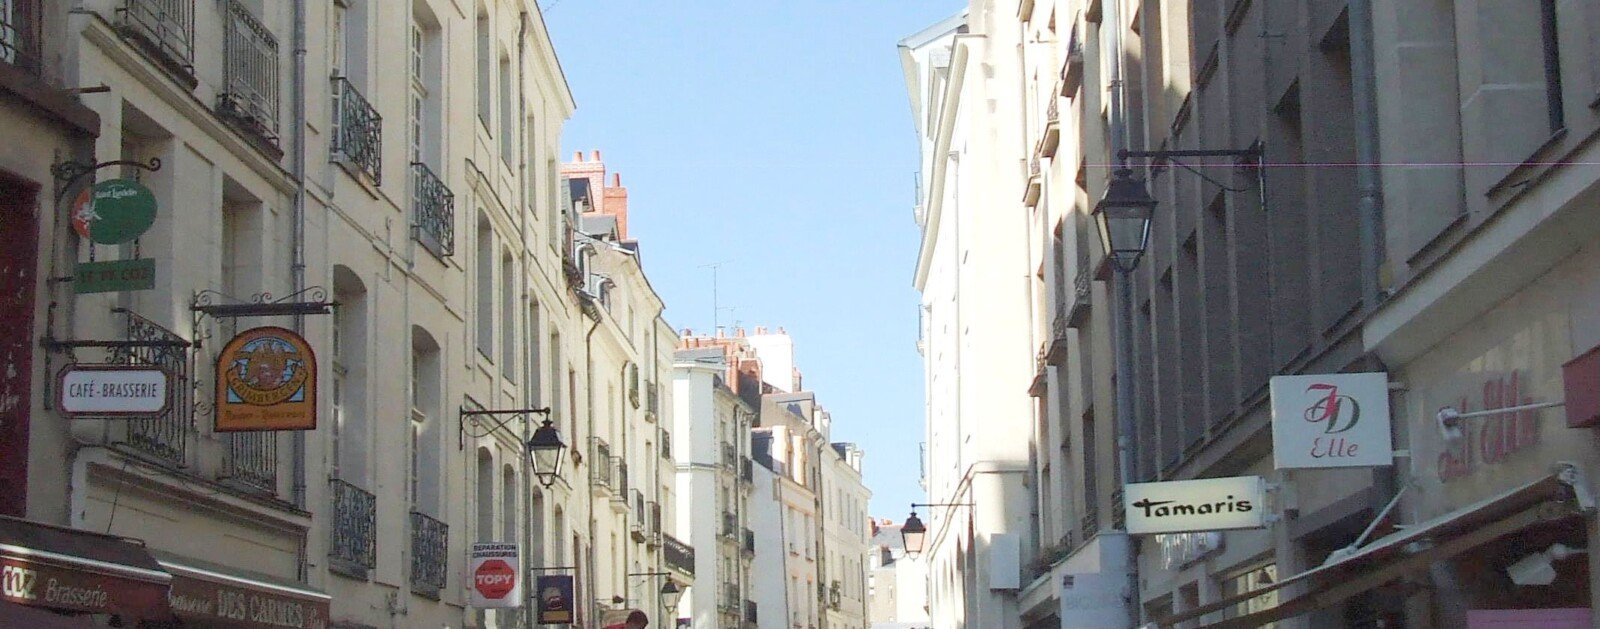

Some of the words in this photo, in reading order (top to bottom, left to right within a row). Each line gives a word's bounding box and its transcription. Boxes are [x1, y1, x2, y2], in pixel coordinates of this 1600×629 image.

[1311, 437, 1359, 459] Elle
[476, 574, 512, 585] TOPY
[45, 578, 108, 608] Brasserie
[217, 590, 246, 620] DES
